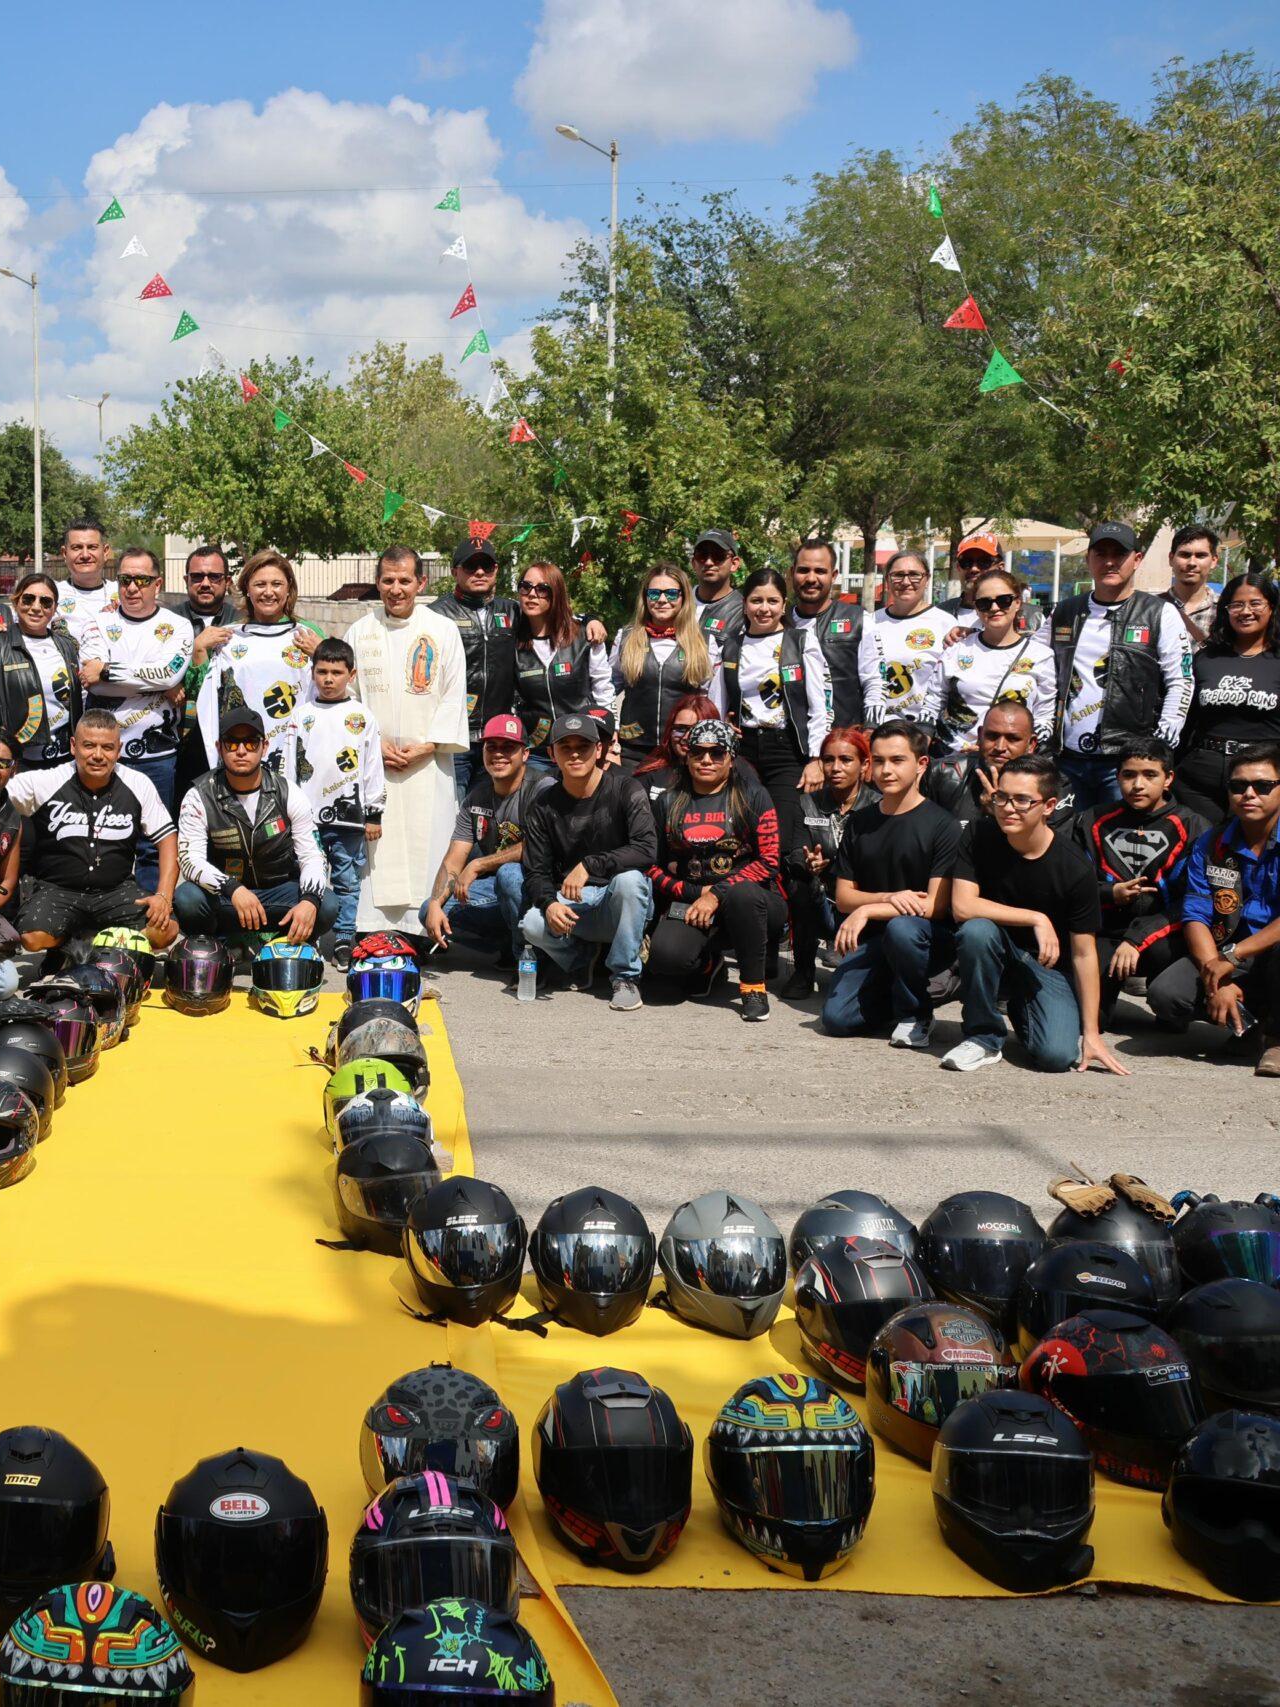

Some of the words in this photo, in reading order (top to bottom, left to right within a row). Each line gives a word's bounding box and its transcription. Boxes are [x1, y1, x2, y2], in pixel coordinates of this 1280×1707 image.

[1247, 690, 1277, 710] RUNS
[47, 800, 134, 832] Yankees
[1207, 866, 1239, 881] MARIO
[446, 1215, 479, 1226] SLEEK
[583, 1221, 617, 1231] SLEEK
[1147, 1365, 1189, 1378] GoPro
[993, 1433, 1059, 1446] LS2
[6, 1475, 38, 1486] MRC
[220, 1499, 260, 1511] BELL
[408, 1505, 475, 1519] LS2
[428, 1658, 478, 1677] ICH
